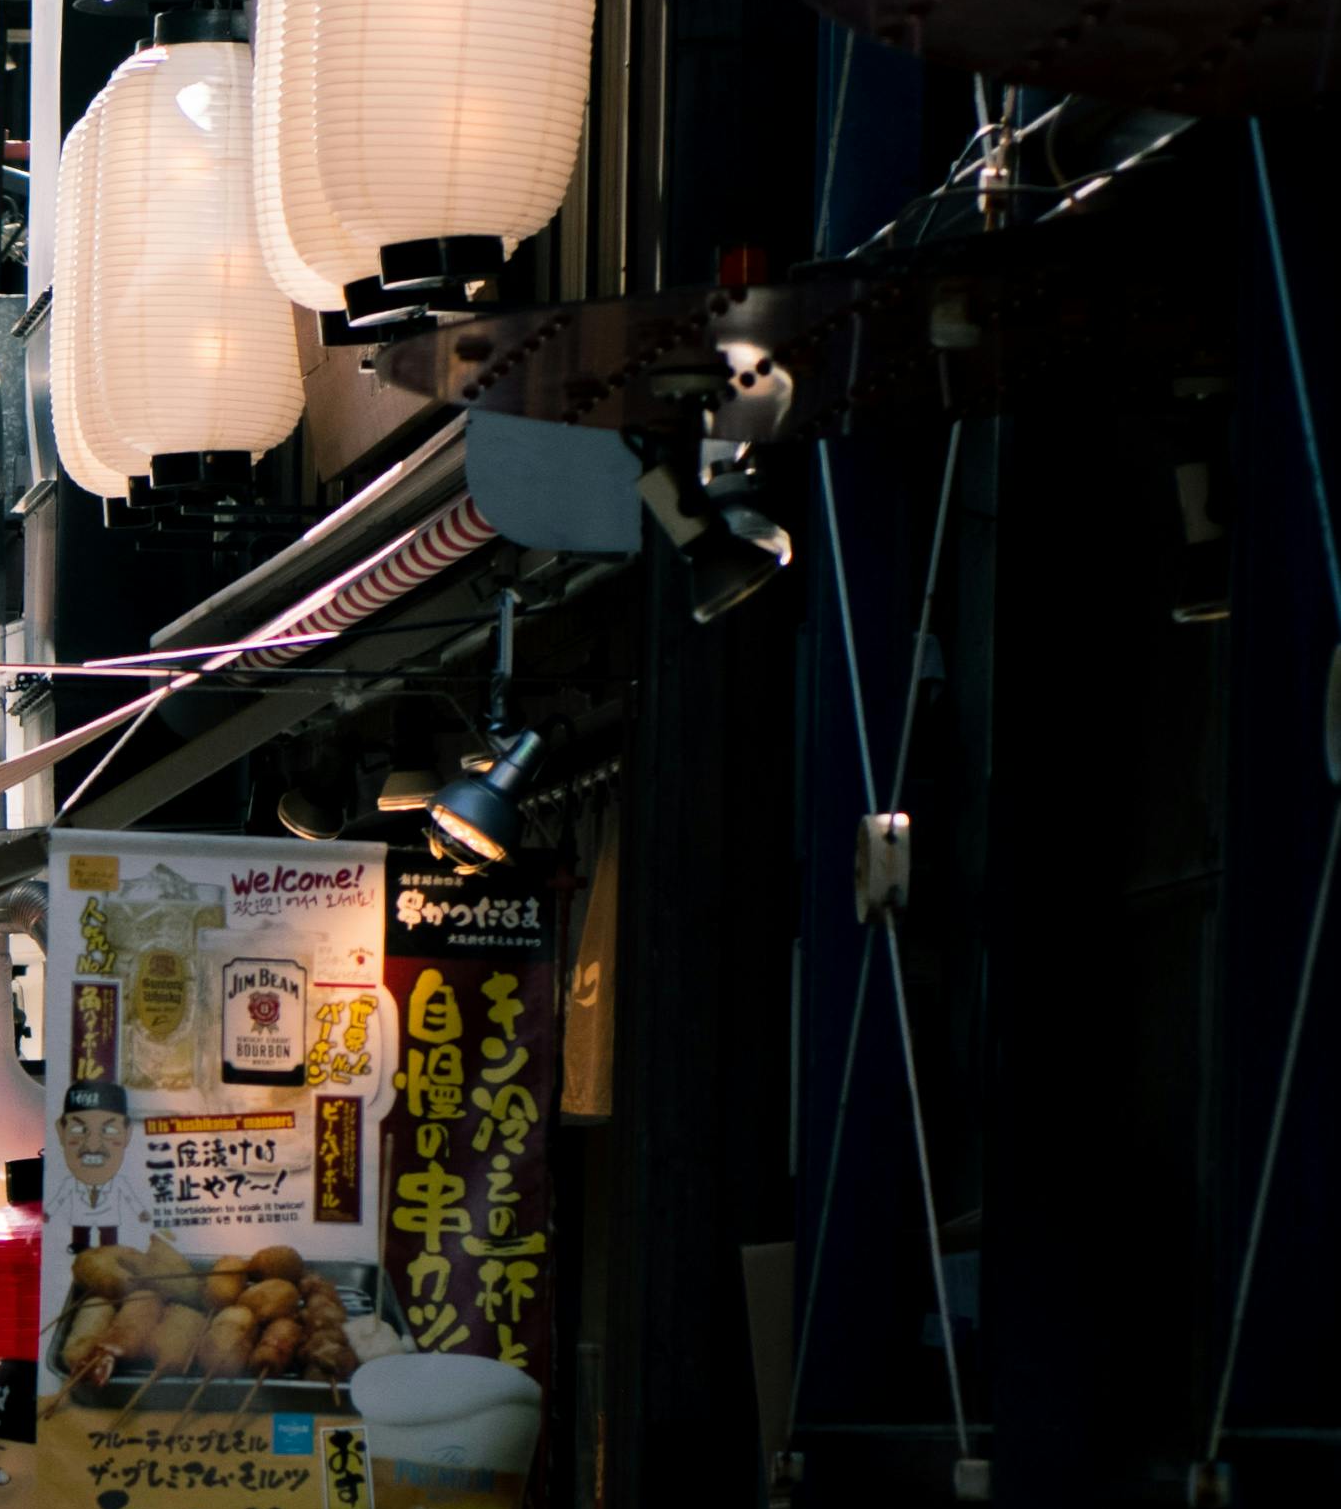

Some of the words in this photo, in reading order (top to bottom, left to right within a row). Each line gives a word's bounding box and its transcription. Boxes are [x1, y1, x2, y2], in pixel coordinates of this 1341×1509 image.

[231, 865, 364, 896] Welcome!
[395, 888, 540, 931] 串かつだるま
[229, 972, 256, 999] JIM
[259, 968, 300, 999] BEAM
[236, 1044, 291, 1058] BOURBON
[146, 1139, 276, 1169] 二度漬けは
